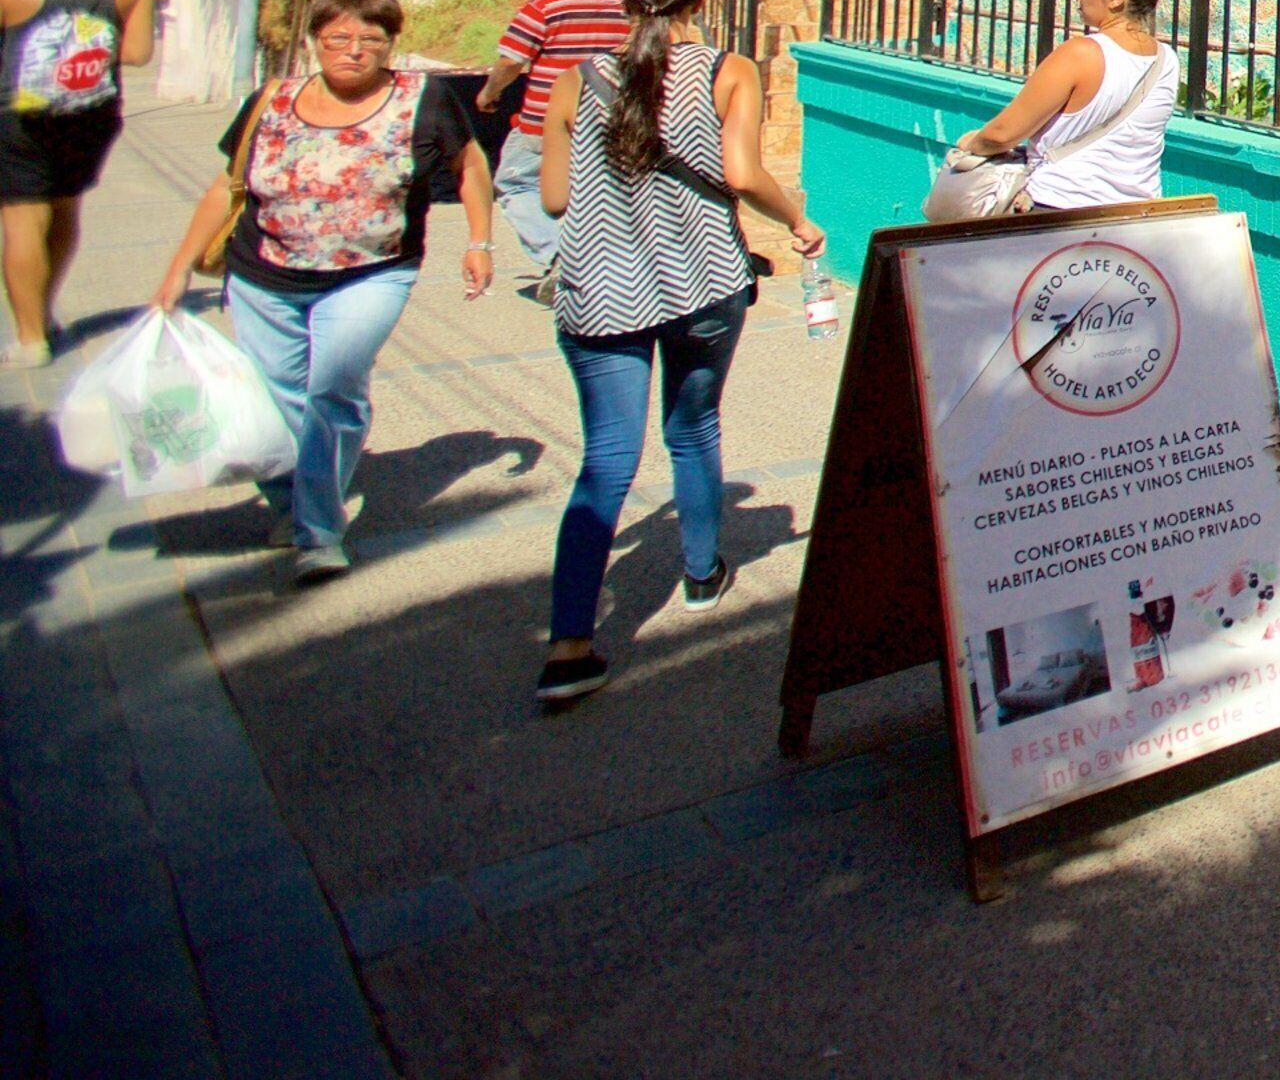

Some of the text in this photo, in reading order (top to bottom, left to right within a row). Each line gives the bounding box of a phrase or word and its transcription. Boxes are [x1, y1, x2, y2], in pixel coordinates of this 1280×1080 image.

[1031, 259, 1157, 323] RESTO-CAFE BELGA
[1044, 348, 1161, 400] HOTEL ART DECO
[978, 460, 1025, 486] MENÚ
[1031, 452, 1086, 475] DIARIO
[1101, 438, 1155, 461] PLATOS
[1158, 435, 1170, 447] A
[1173, 428, 1191, 444] LA
[1194, 420, 1241, 441] CARTA
[1005, 442, 1225, 502] SABORES CHILENOS Y BELGAS
[974, 454, 1255, 530] CERVEZAS BELGAS Y VINOS CHILENOS
[987, 512, 1262, 594] HABITACIONES CON BAÑO PRIVADO
[1014, 499, 1235, 565] CONFORTABLES Y MODERNAS
[1011, 709, 1137, 768] RESERVAS
[1150, 691, 1192, 719] 032
